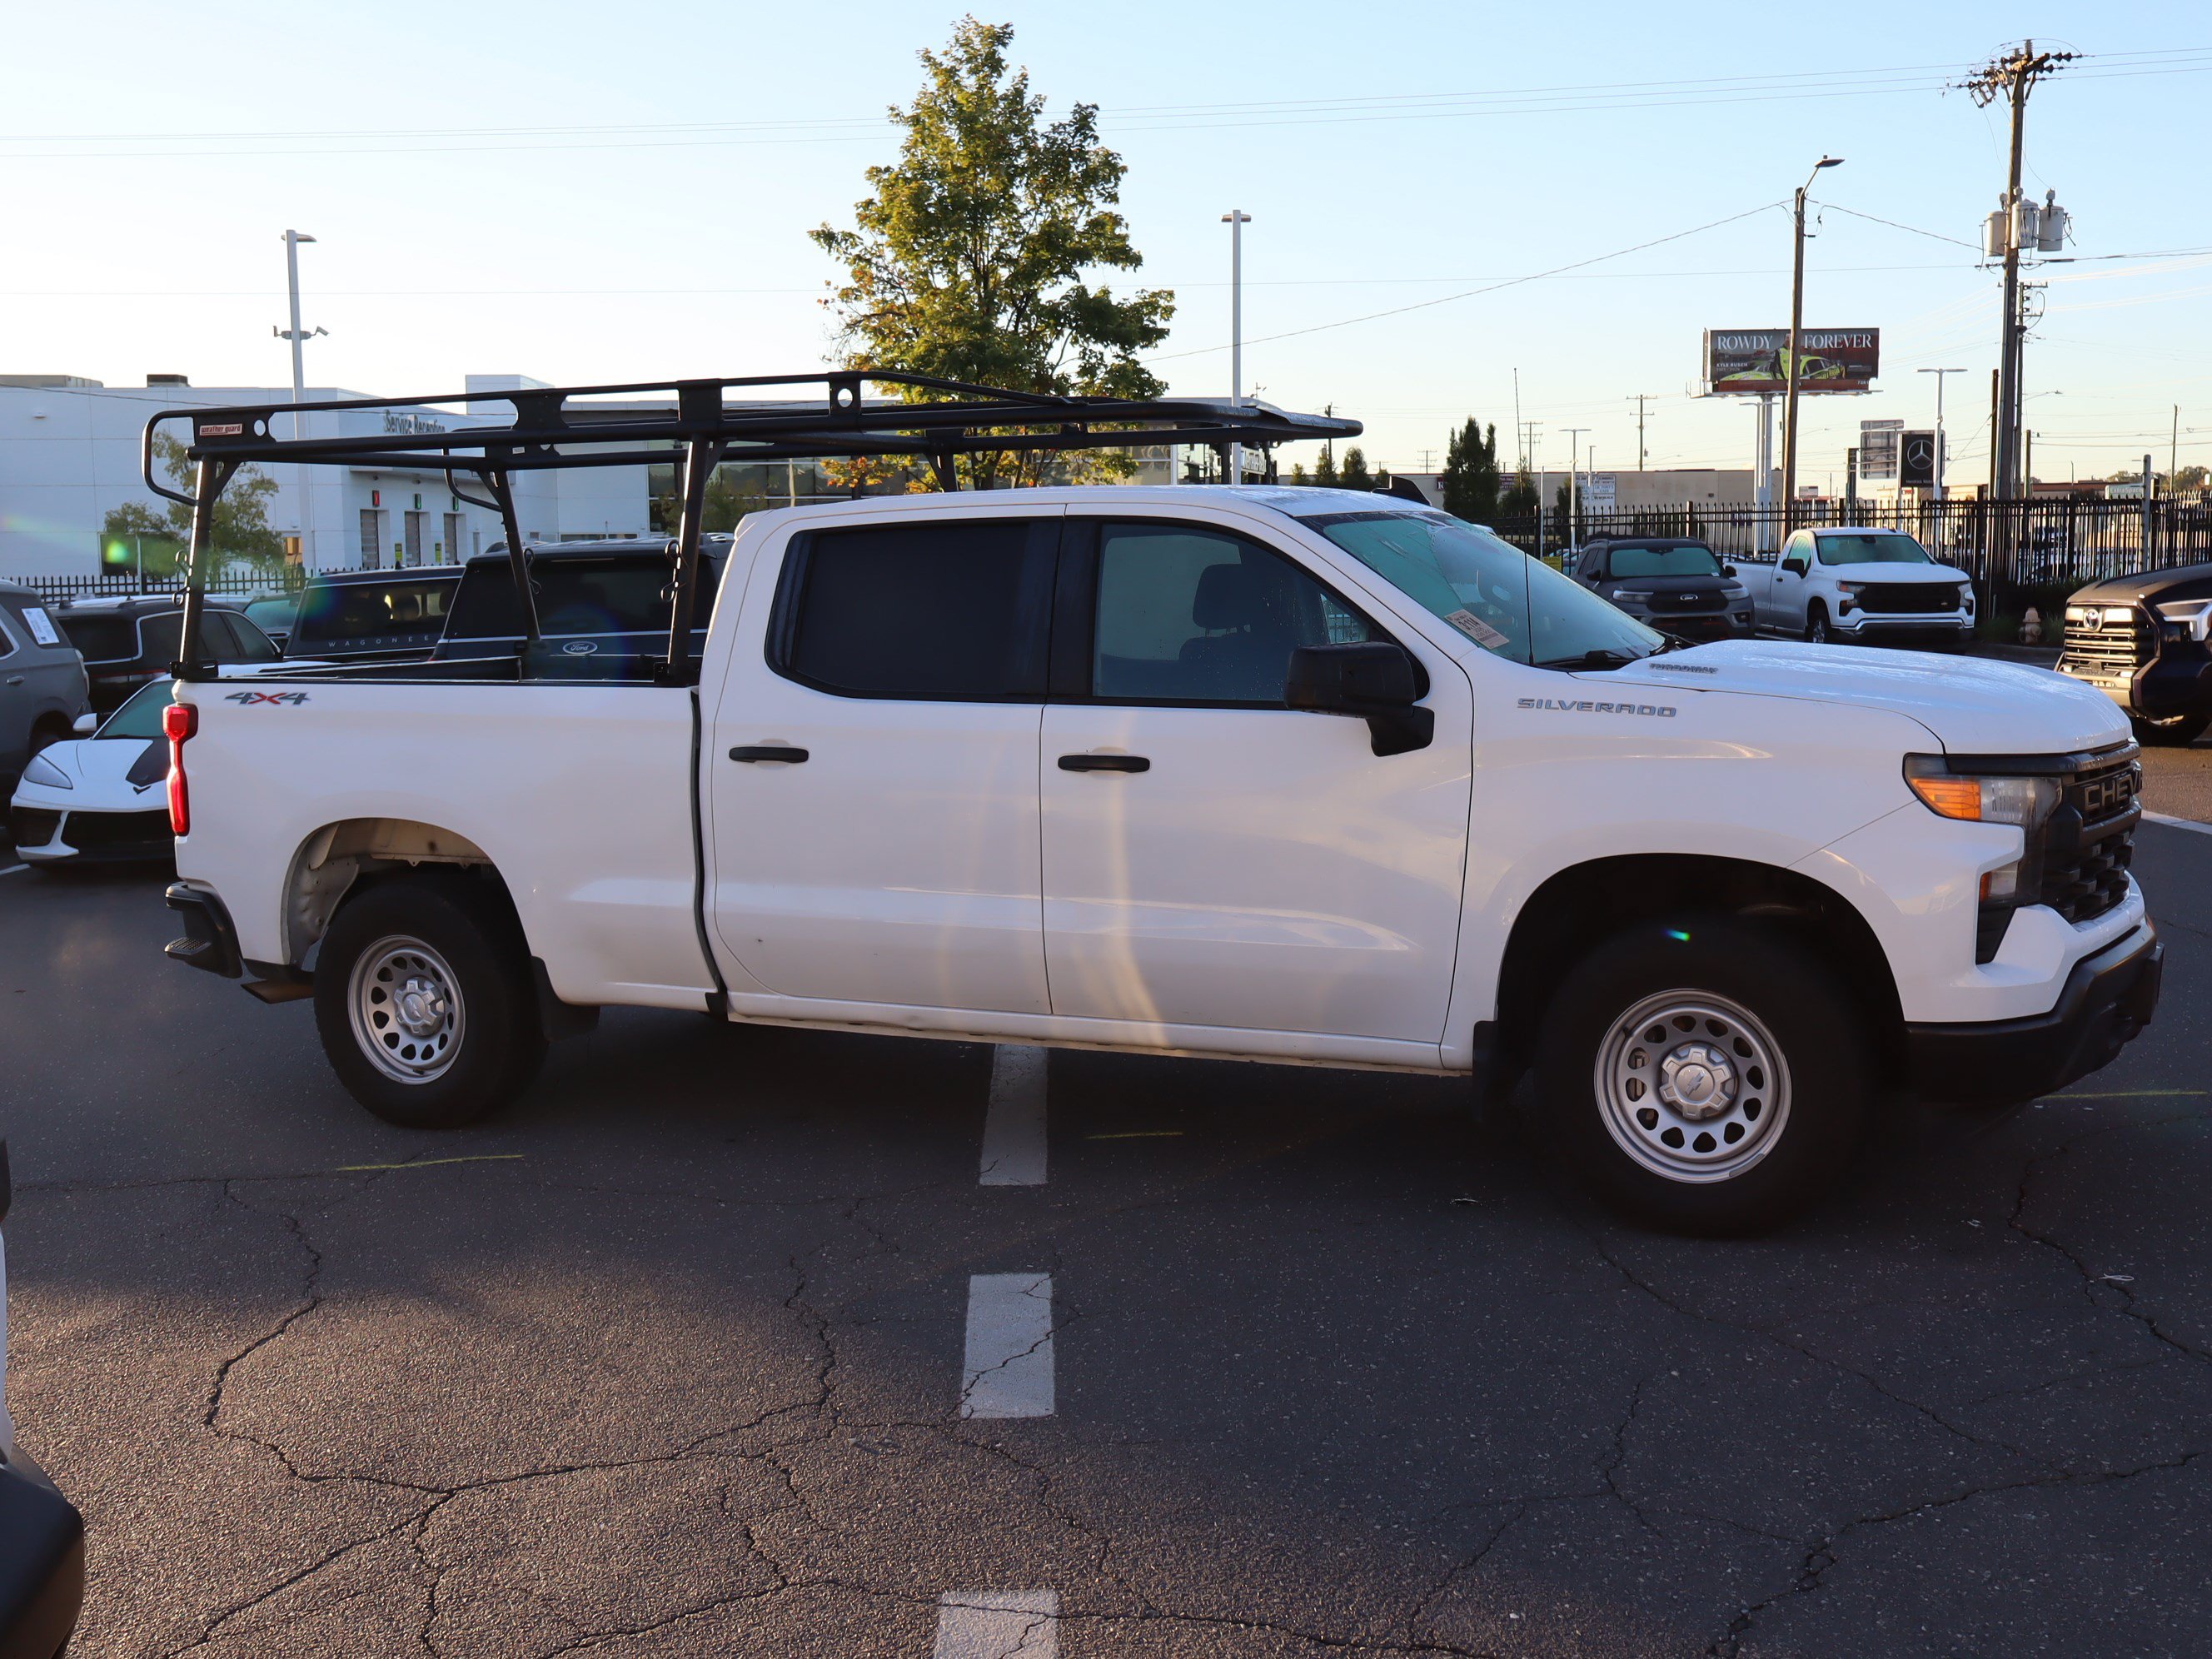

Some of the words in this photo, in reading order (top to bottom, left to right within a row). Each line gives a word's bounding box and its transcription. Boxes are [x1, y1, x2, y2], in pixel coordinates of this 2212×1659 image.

[1717, 335, 1773, 350] ROWDY
[1804, 334, 1872, 349] FOREVER
[225, 425, 241, 433] guard
[384, 409, 413, 434] Service
[328, 635, 429, 648] WAGONEE
[1517, 698, 1676, 717] SILVERADO
[2084, 773, 2140, 811] CHEV
